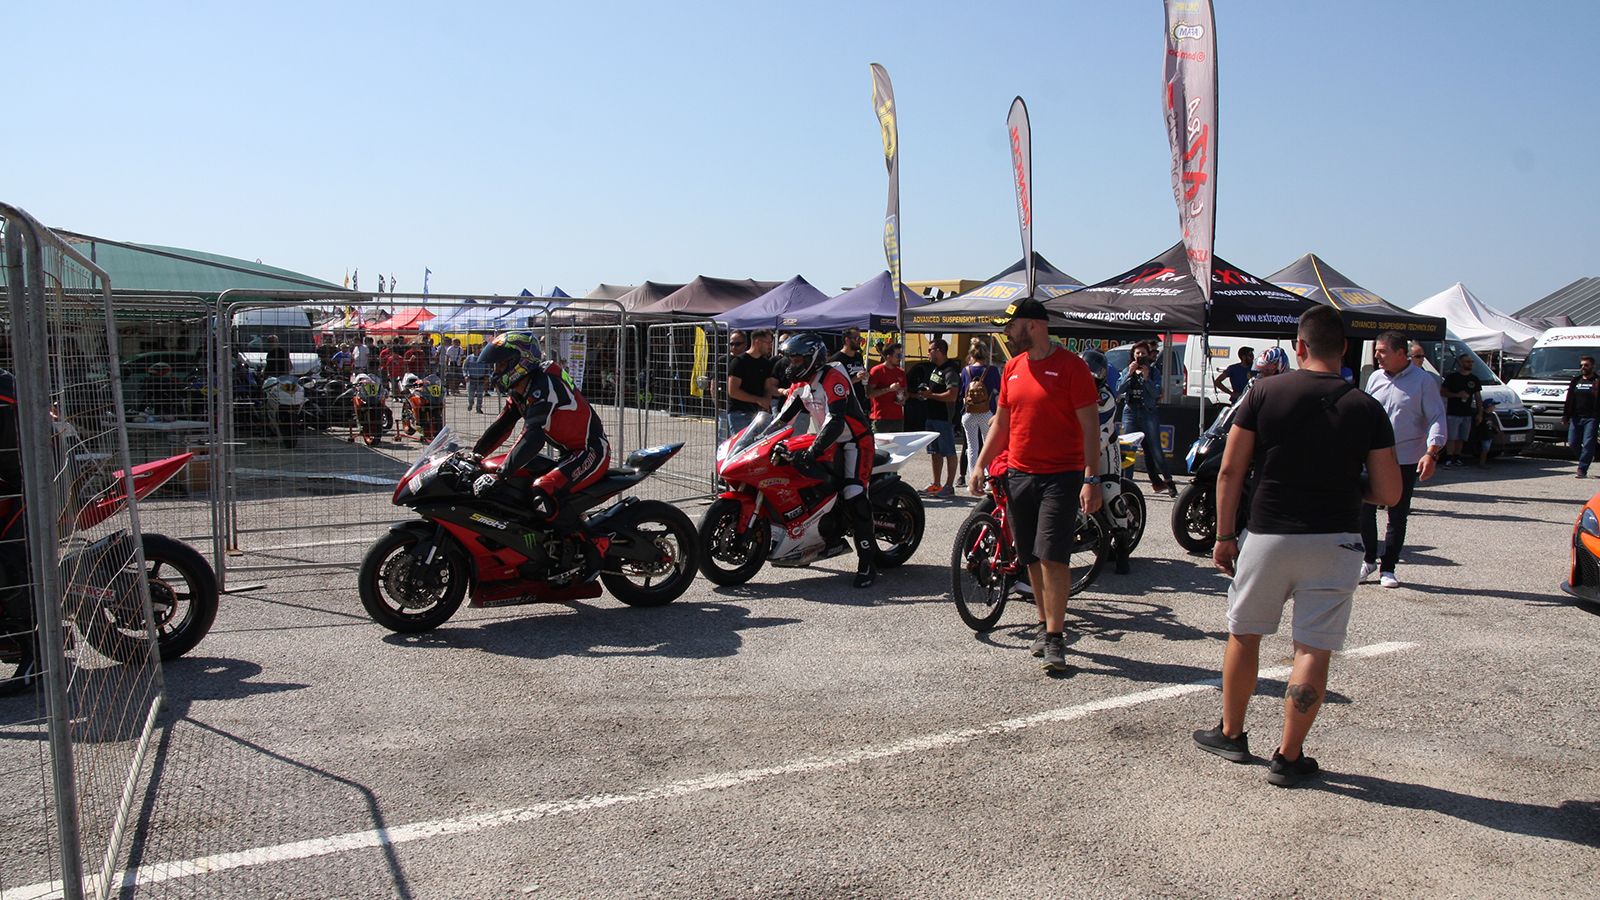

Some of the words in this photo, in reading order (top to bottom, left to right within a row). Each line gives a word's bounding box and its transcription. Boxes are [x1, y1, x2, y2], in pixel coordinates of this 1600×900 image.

[912, 315, 941, 324] ADVANCED
[942, 315, 976, 324] SUSPENSION
[1063, 310, 1166, 324] www.extraproducts.gr
